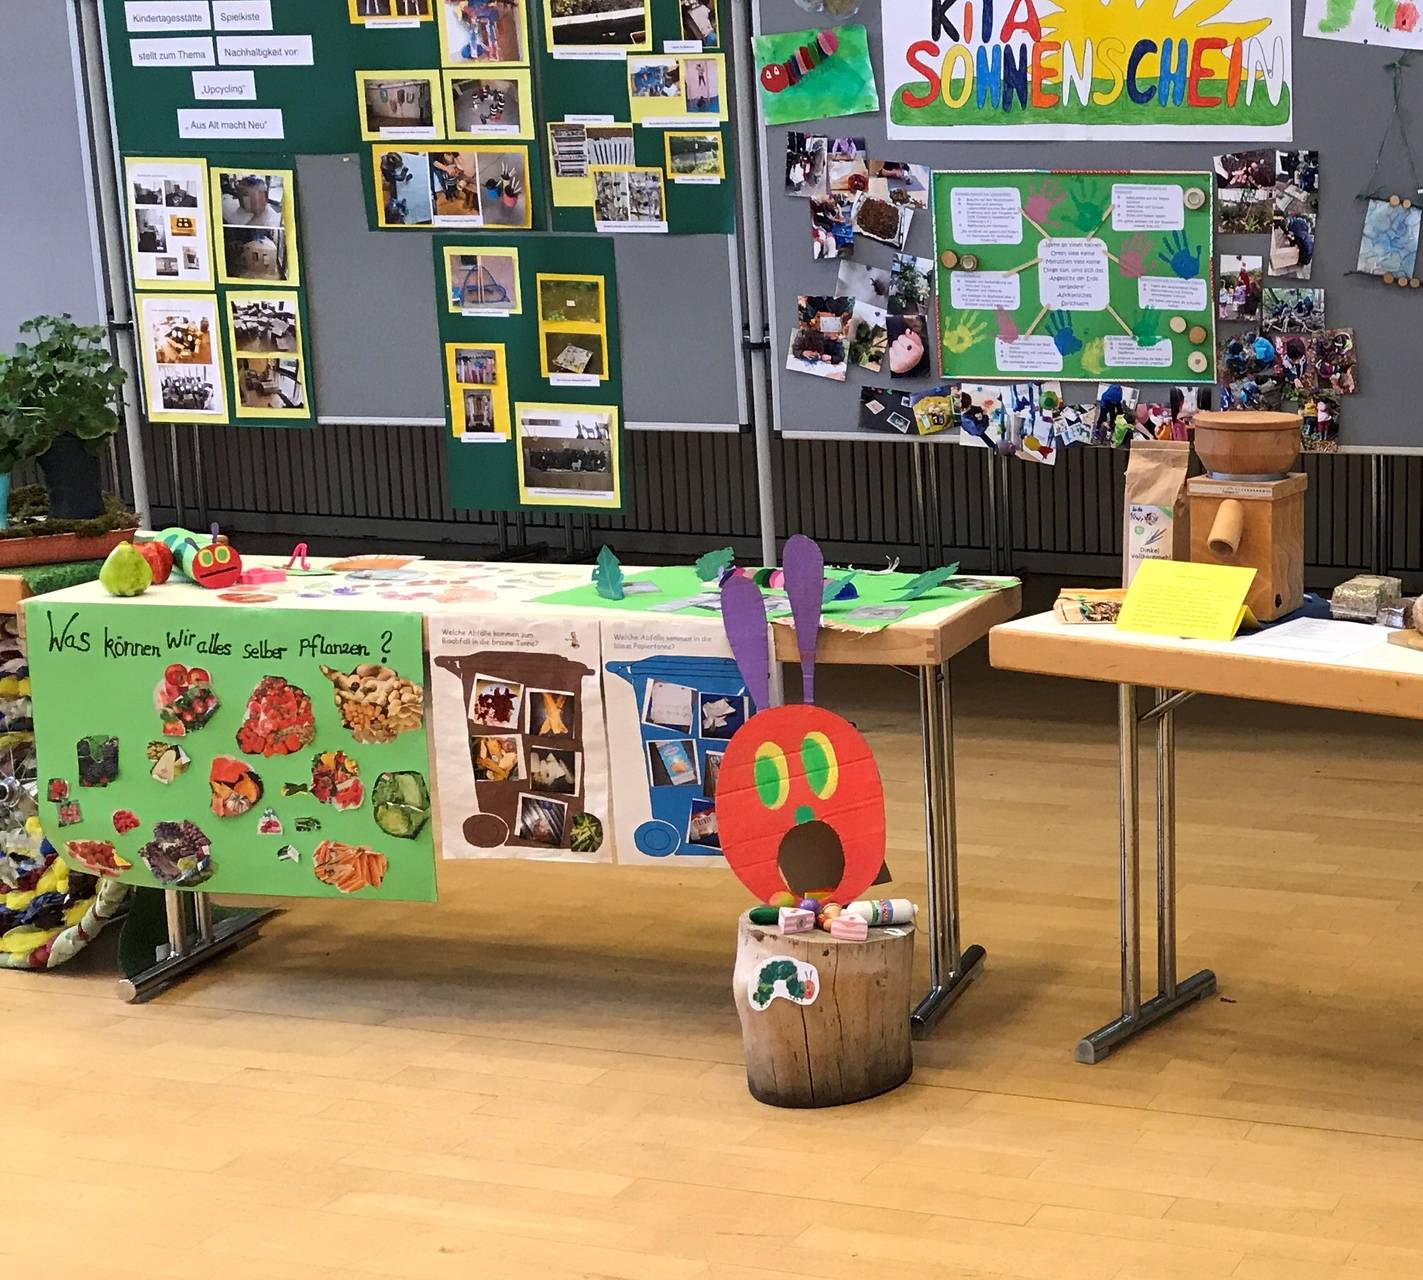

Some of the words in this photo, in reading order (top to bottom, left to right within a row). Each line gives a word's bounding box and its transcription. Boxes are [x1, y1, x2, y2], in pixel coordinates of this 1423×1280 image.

[132, 14, 203, 25] Kindertagesstätte
[220, 12, 261, 23] Spielkiste
[138, 51, 157, 61] stellt
[177, 50, 206, 60] Thema
[224, 48, 283, 59] Nachhaltigkeit
[284, 48, 298, 56] vor
[902, 37, 1285, 112] SONNENSCHEIN
[190, 120, 207, 130] Aus
[208, 120, 219, 130] Alt
[221, 120, 247, 130] macht
[1140, 546, 1160, 554] Dinkel
[47, 611, 91, 652] Was
[104, 626, 162, 659] können
[196, 631, 232, 656] alles
